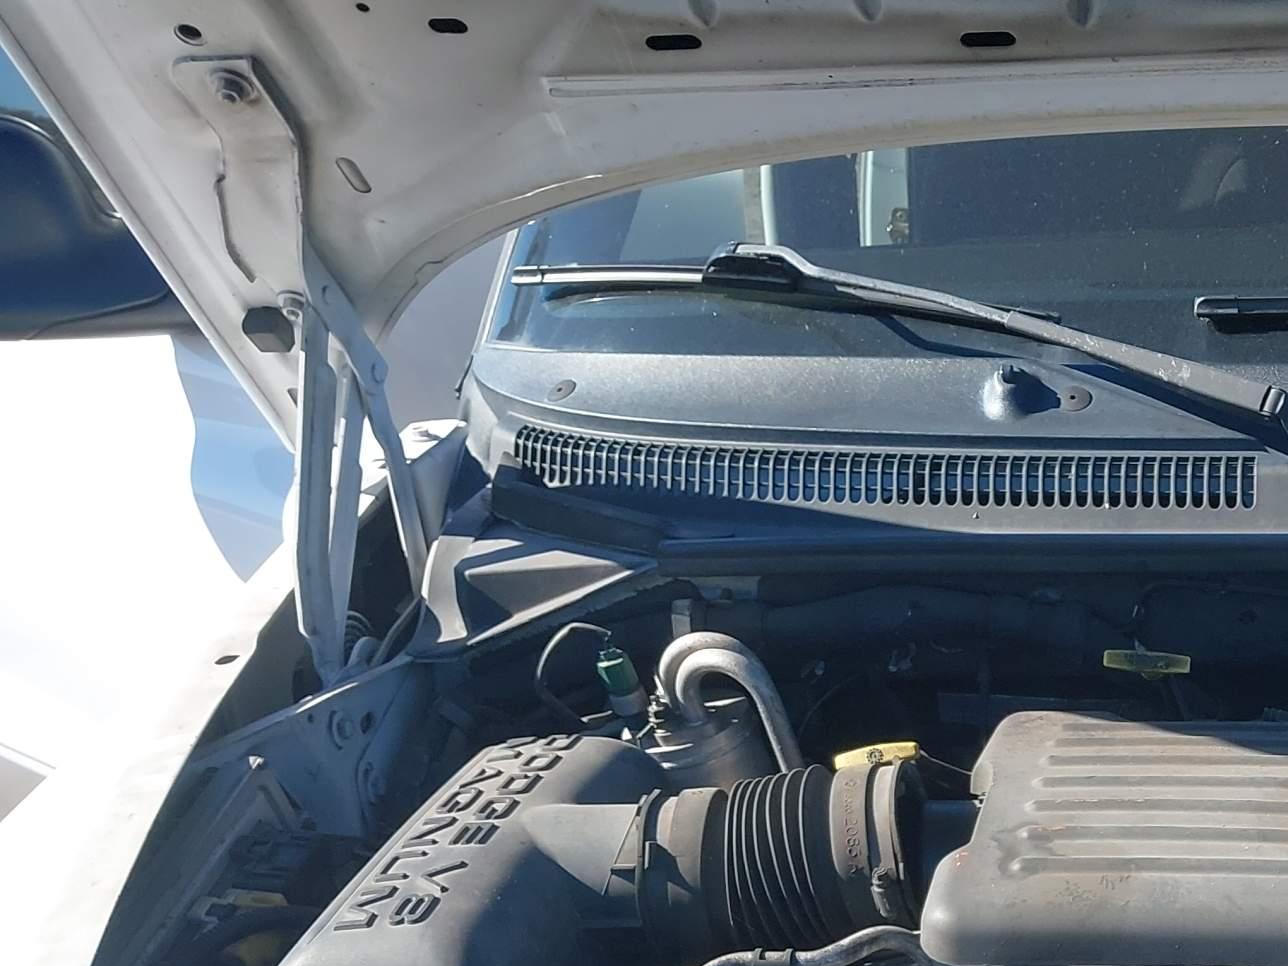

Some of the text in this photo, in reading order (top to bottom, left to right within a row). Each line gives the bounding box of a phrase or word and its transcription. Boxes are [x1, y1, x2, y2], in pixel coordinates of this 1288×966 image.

[333, 736, 540, 932] MAGNUM
[388, 733, 584, 926] DODGE V8
